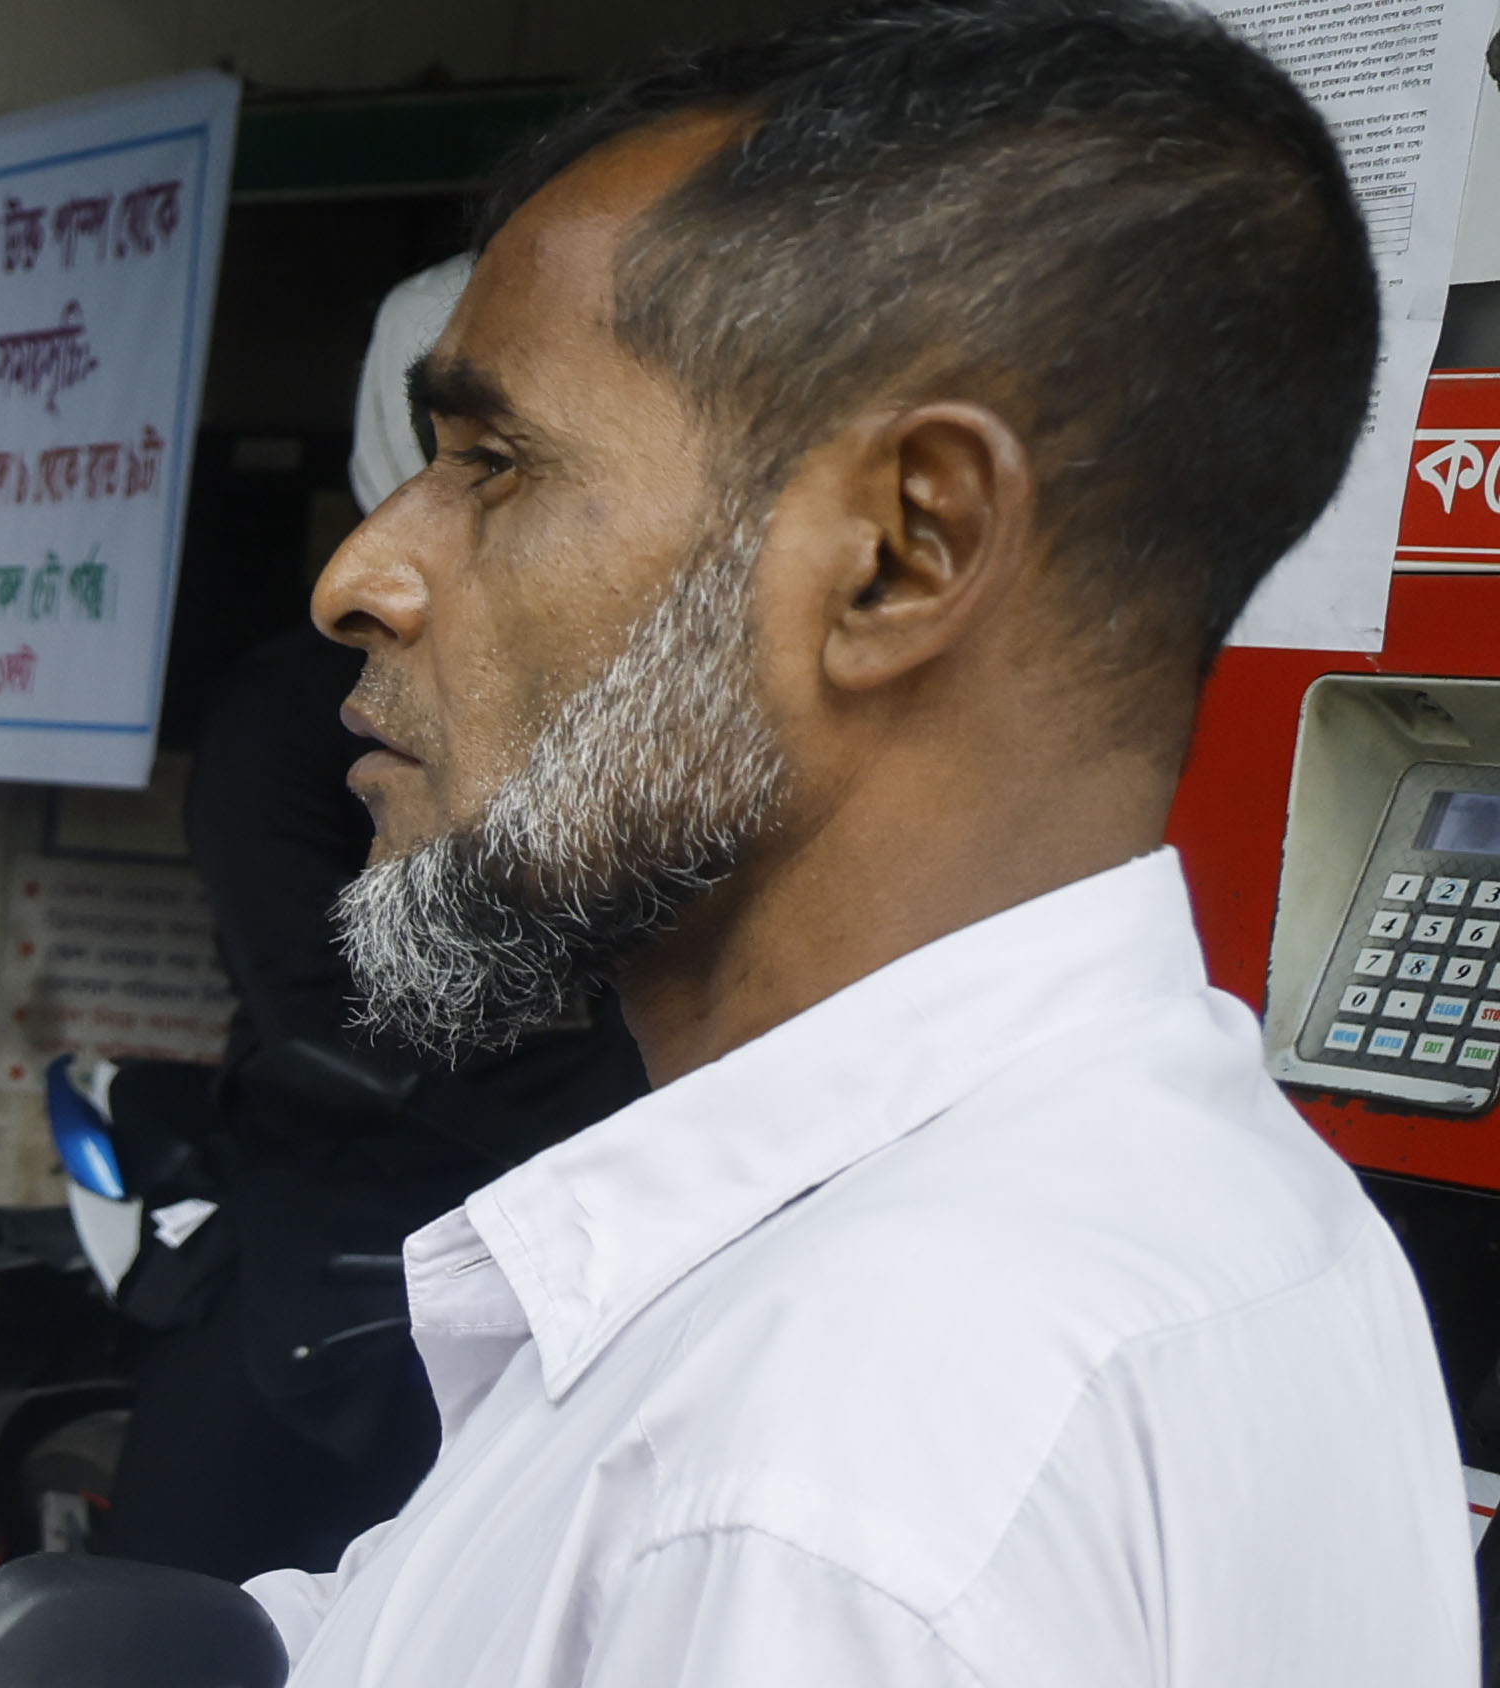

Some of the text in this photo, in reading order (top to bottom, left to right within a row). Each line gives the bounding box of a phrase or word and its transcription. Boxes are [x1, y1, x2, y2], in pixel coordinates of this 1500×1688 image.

[1397, 880, 1411, 896] 1
[1439, 883, 1455, 899] 2
[1485, 886, 1500, 904] 3
[1381, 917, 1397, 933] 4
[1424, 921, 1442, 938] 5
[1470, 926, 1486, 942] 6
[1366, 954, 1381, 970] 7
[1409, 959, 1425, 975] 8
[1455, 964, 1471, 980] 9
[1352, 991, 1367, 1007] 0
[1433, 1002, 1463, 1017] CLEAR
[1481, 1007, 1500, 1021] STO
[1422, 1040, 1444, 1055] EXIT
[1463, 1046, 1495, 1061] START
